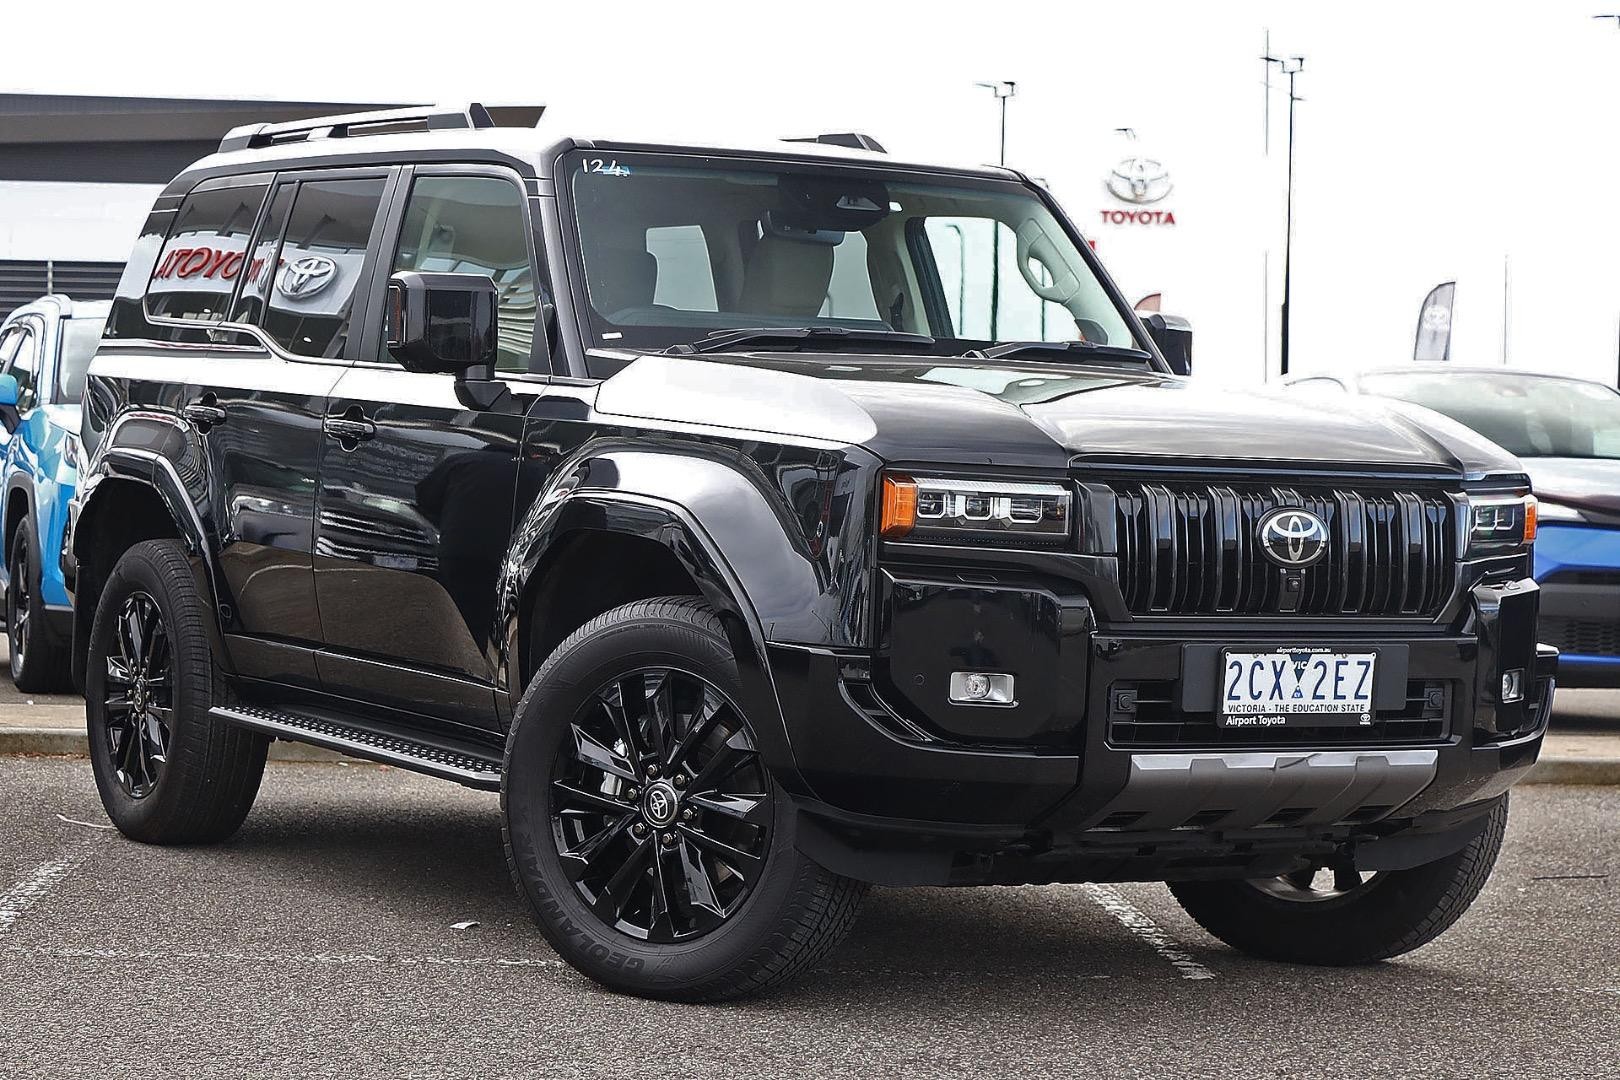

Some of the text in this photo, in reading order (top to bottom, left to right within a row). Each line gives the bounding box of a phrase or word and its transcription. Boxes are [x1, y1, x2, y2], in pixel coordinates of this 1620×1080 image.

[1100, 210, 1175, 225] TOYOTA
[1227, 660, 1371, 700] 2CX 2EZ
[1228, 704, 1266, 713] VICTORIA
[1275, 704, 1290, 713] THE
[1292, 704, 1339, 713] EDUCATION
[1341, 704, 1365, 712] STATE
[1226, 715, 1286, 726] Airport Toyota
